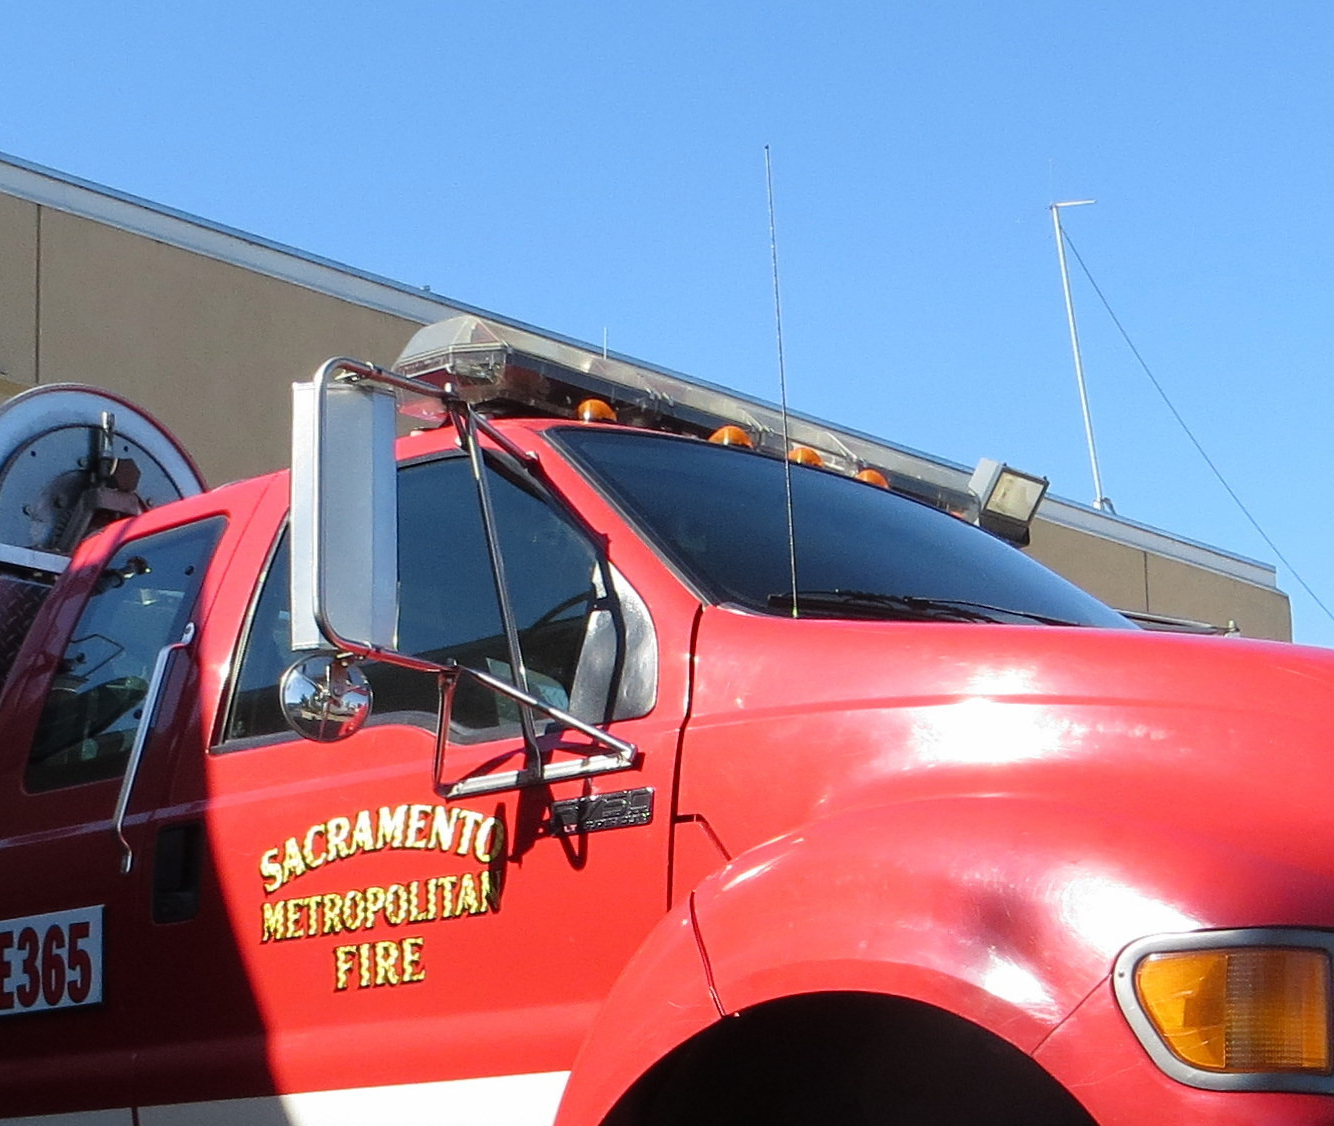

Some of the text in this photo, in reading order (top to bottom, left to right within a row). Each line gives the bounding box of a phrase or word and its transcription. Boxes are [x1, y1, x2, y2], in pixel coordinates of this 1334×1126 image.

[259, 804, 505, 892] SACRAMENTO
[261, 870, 501, 943] METROPOLITAN
[334, 937, 426, 991] FIRE
